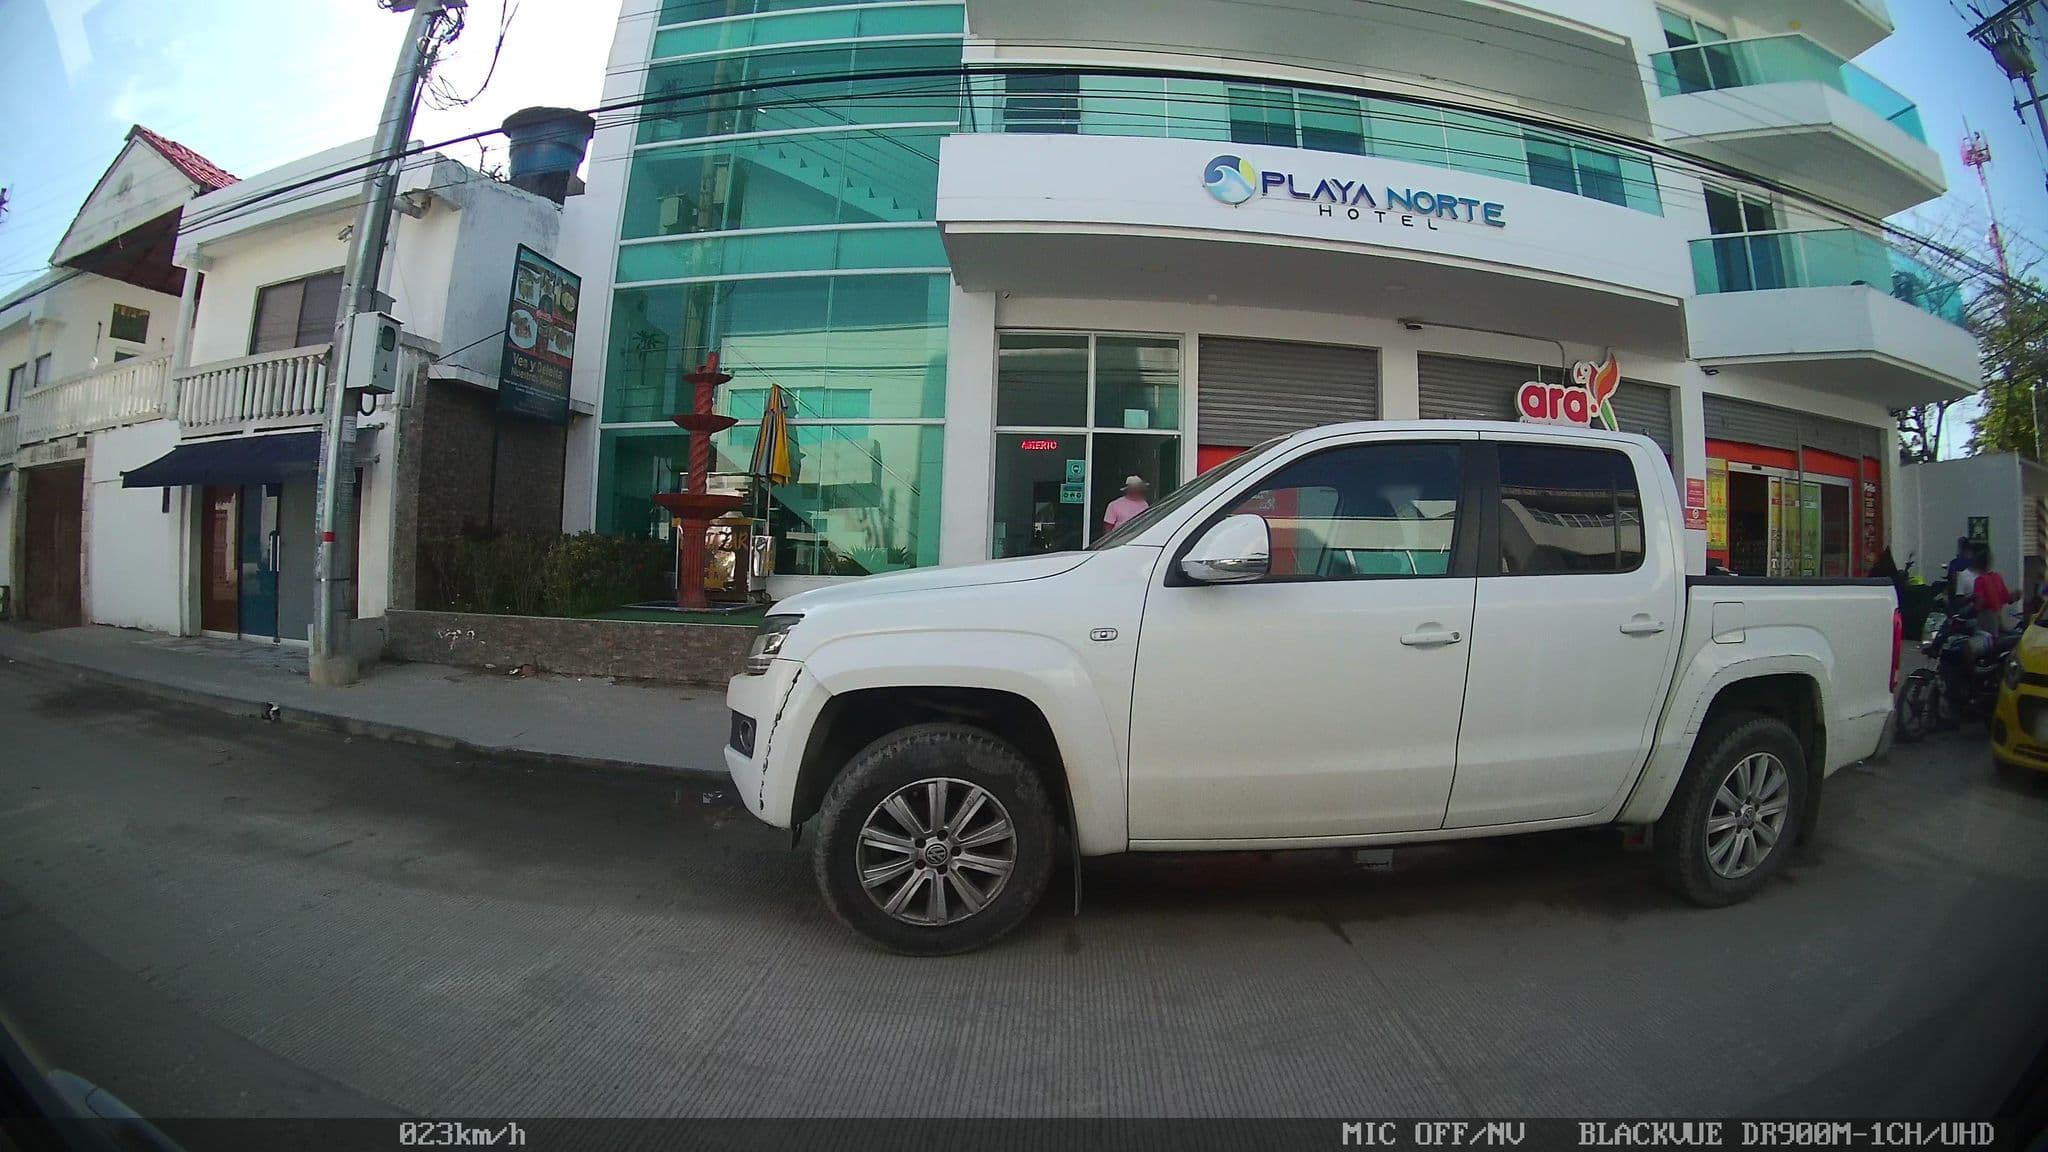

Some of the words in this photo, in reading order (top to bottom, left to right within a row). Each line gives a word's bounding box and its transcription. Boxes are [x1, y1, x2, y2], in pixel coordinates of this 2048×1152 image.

[1261, 170, 1377, 208] PLAYA
[1386, 185, 1507, 228] NORTE
[1319, 204, 1438, 231] HOTEL
[1520, 385, 1589, 423] ara
[1021, 440, 1057, 450] ABIERTO
